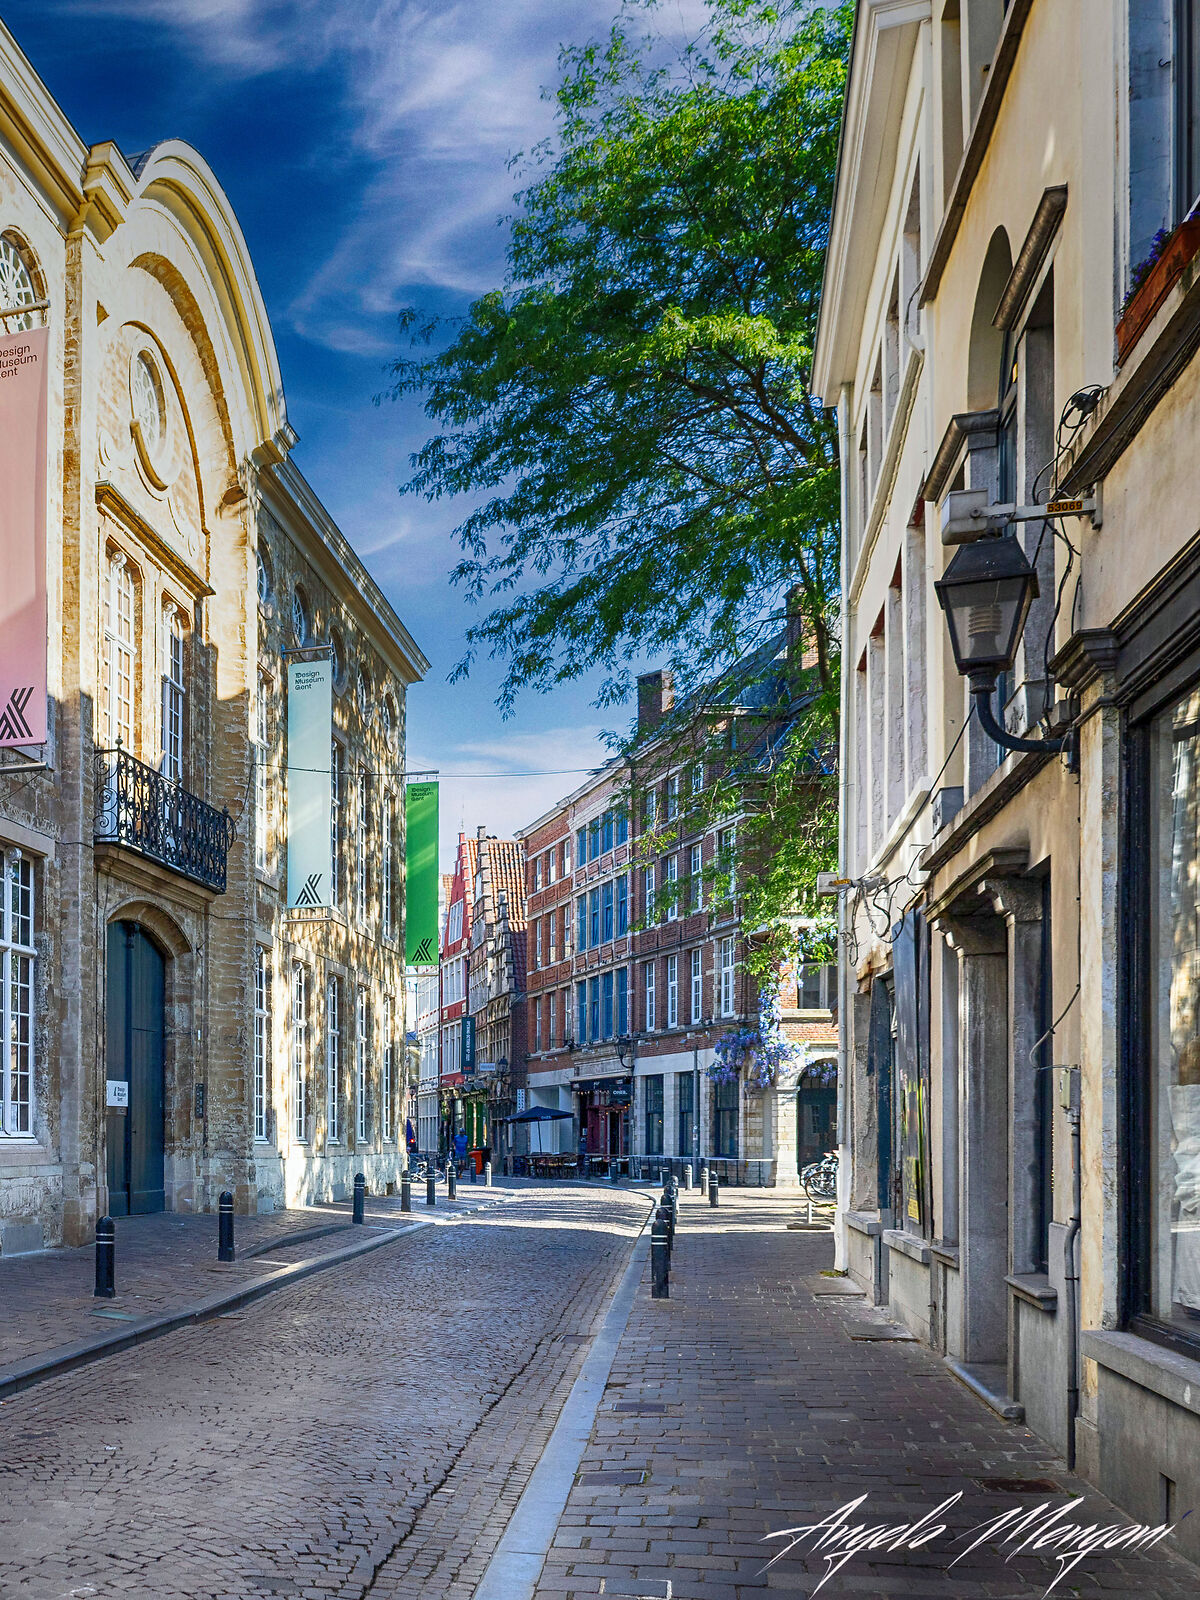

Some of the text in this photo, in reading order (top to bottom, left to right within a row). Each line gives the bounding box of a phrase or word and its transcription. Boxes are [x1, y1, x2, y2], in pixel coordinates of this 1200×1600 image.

[1047, 500, 1083, 513] 53069
[294, 671, 321, 679] Design
[294, 677, 325, 685] Museum
[294, 683, 312, 691] Gent
